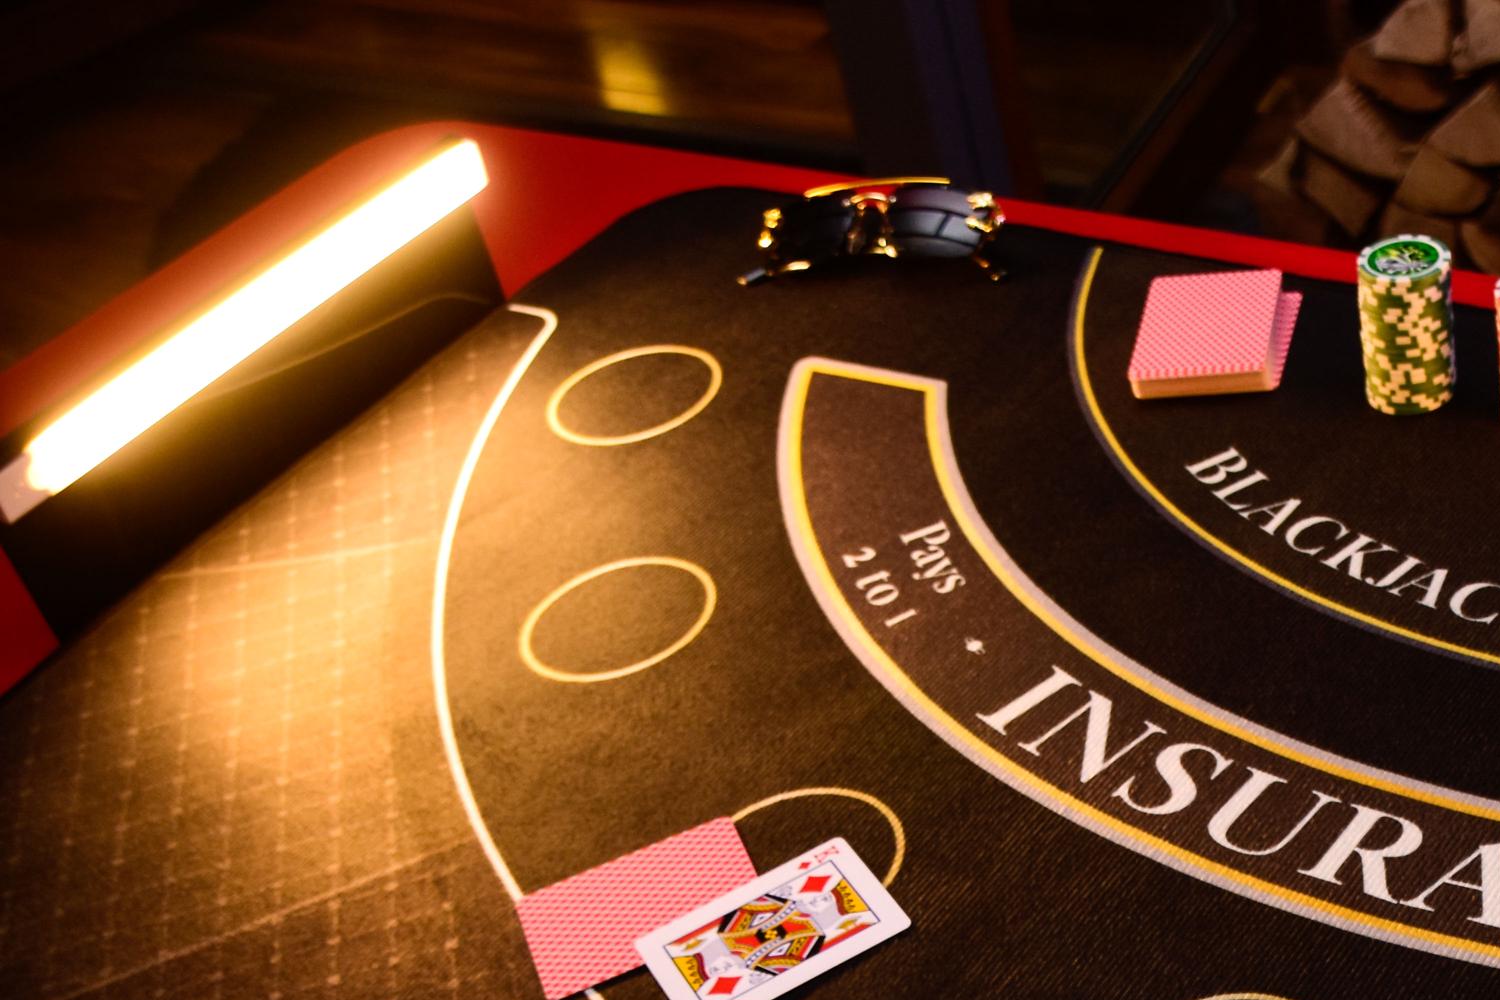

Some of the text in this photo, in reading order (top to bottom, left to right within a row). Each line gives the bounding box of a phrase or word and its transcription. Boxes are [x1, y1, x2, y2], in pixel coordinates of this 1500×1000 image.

[842, 547, 918, 628] 2 to 1
[900, 519, 967, 595] Pays
